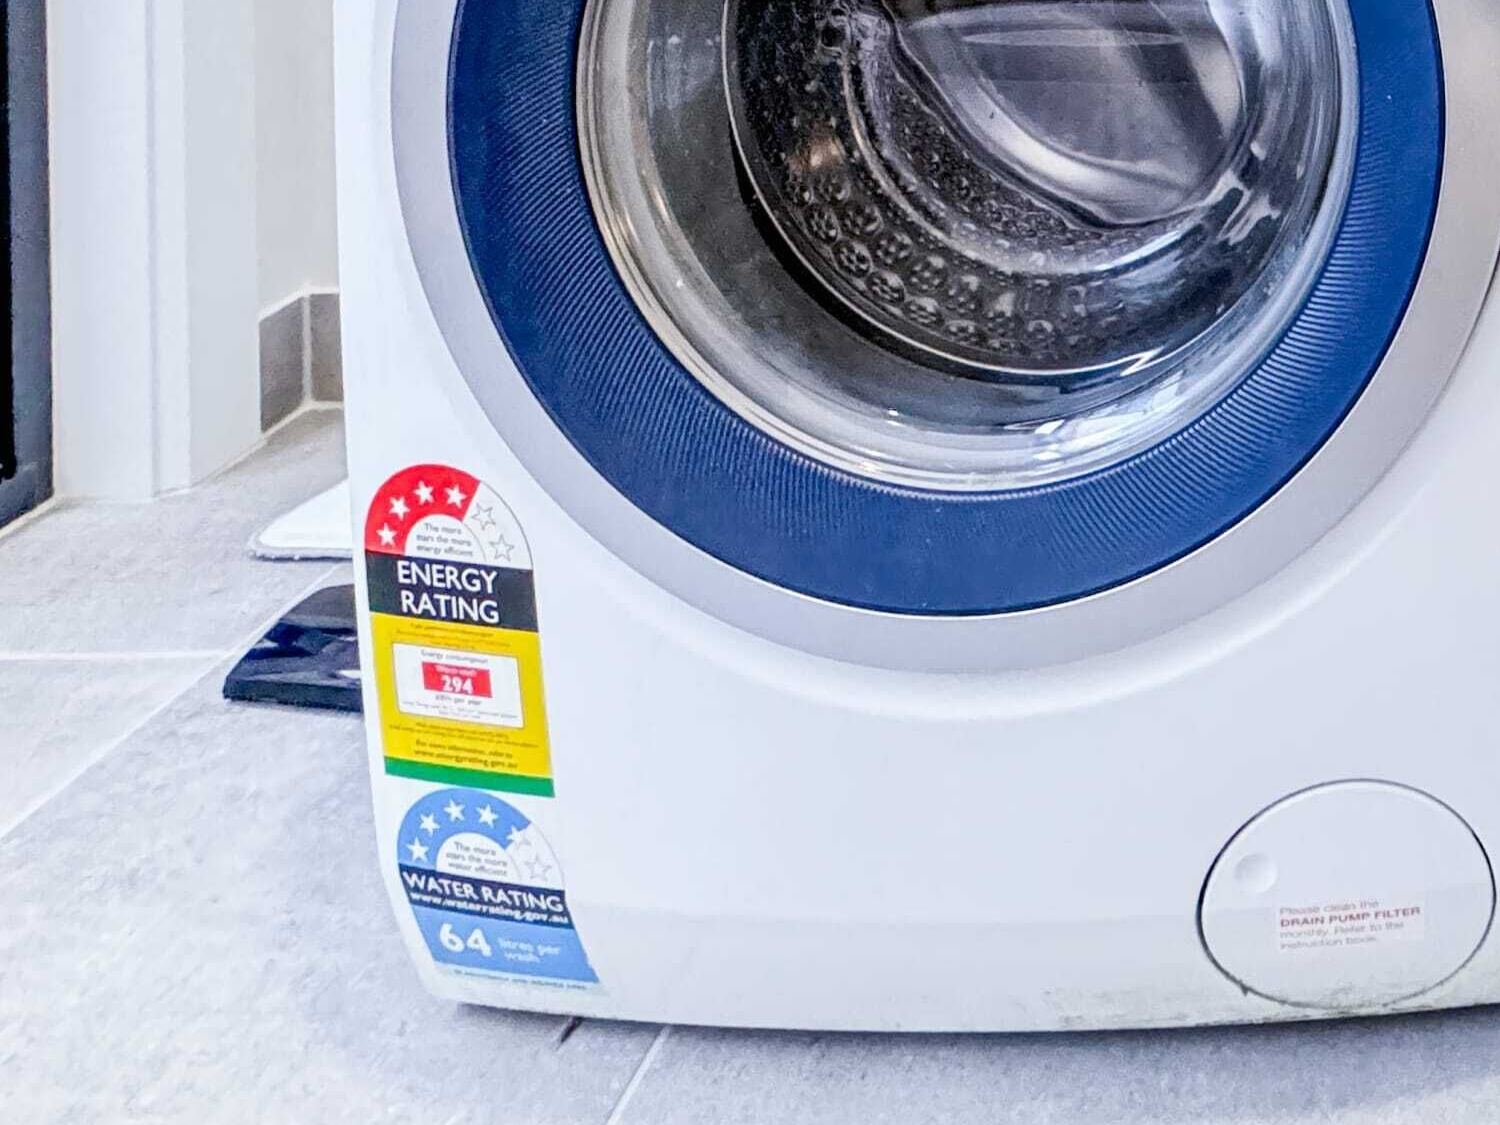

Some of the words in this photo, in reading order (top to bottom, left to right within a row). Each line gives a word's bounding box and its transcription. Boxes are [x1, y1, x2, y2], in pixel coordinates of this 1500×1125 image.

[397, 560, 498, 594] ENERGY
[400, 591, 500, 624] RATING
[441, 676, 474, 694] 294
[454, 841, 471, 853] The
[473, 847, 497, 857] more
[402, 871, 478, 900] WATER
[482, 886, 565, 913] RATING
[1279, 903, 1320, 916] Please
[1324, 901, 1356, 913] clean
[1360, 899, 1379, 910] the
[1280, 916, 1325, 928] DRAIN
[1328, 911, 1370, 925] PUMP
[1374, 906, 1421, 920] FILTER
[1334, 923, 1365, 936] Refer
[1370, 922, 1383, 933] to
[1386, 919, 1405, 931] the
[440, 923, 492, 957] 64
[1280, 936, 1343, 951] instruction
